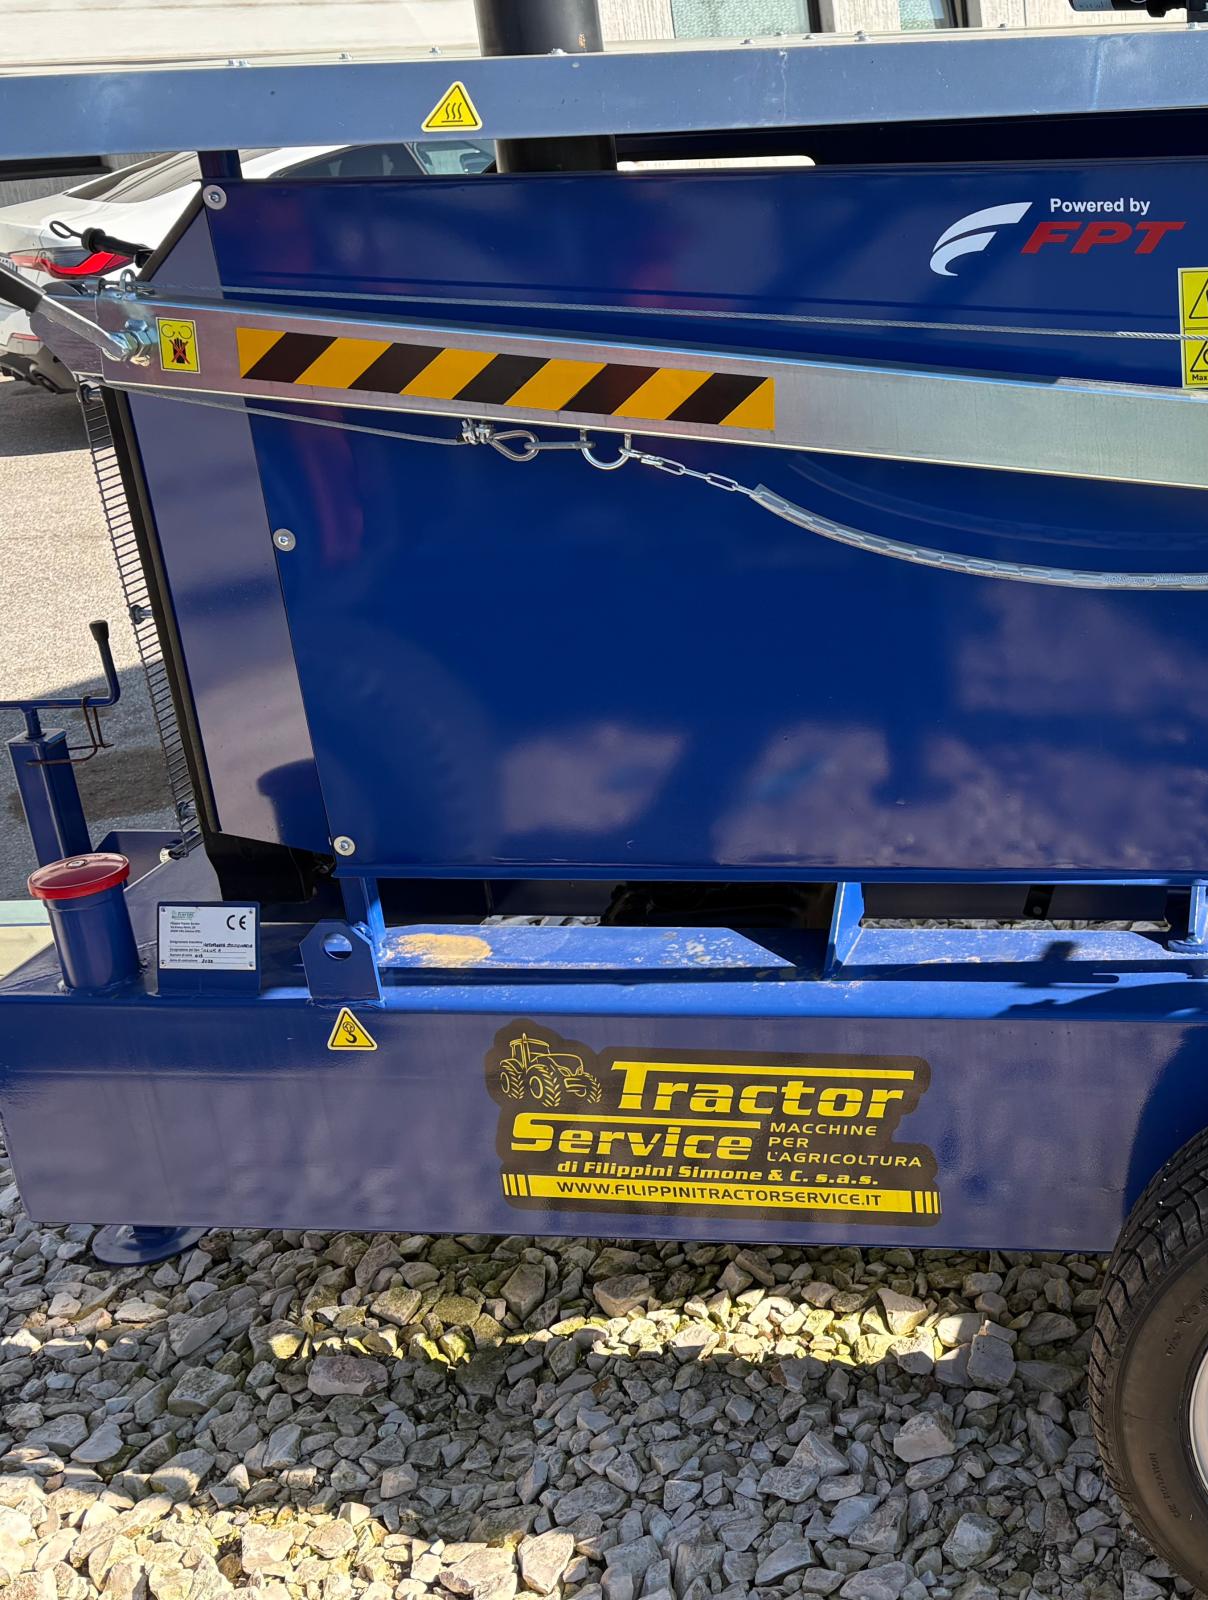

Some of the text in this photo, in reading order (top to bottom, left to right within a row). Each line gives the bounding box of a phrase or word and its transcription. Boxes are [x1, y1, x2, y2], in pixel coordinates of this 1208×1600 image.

[1050, 198, 1150, 215] Powered by
[1020, 221, 1186, 254] FPT
[226, 914, 247, 931] CE
[611, 1060, 915, 1119] Tractor
[511, 1112, 761, 1161] Service
[770, 1121, 878, 1136] MACCHINE
[768, 1136, 809, 1149] PER
[766, 1150, 923, 1168] L'AGRICOLTURA
[557, 1160, 879, 1186] di Filippini Simone & C. s.a.s.
[556, 1180, 882, 1207] WWW.FILIPPINITRACTORSERVICE.IT
